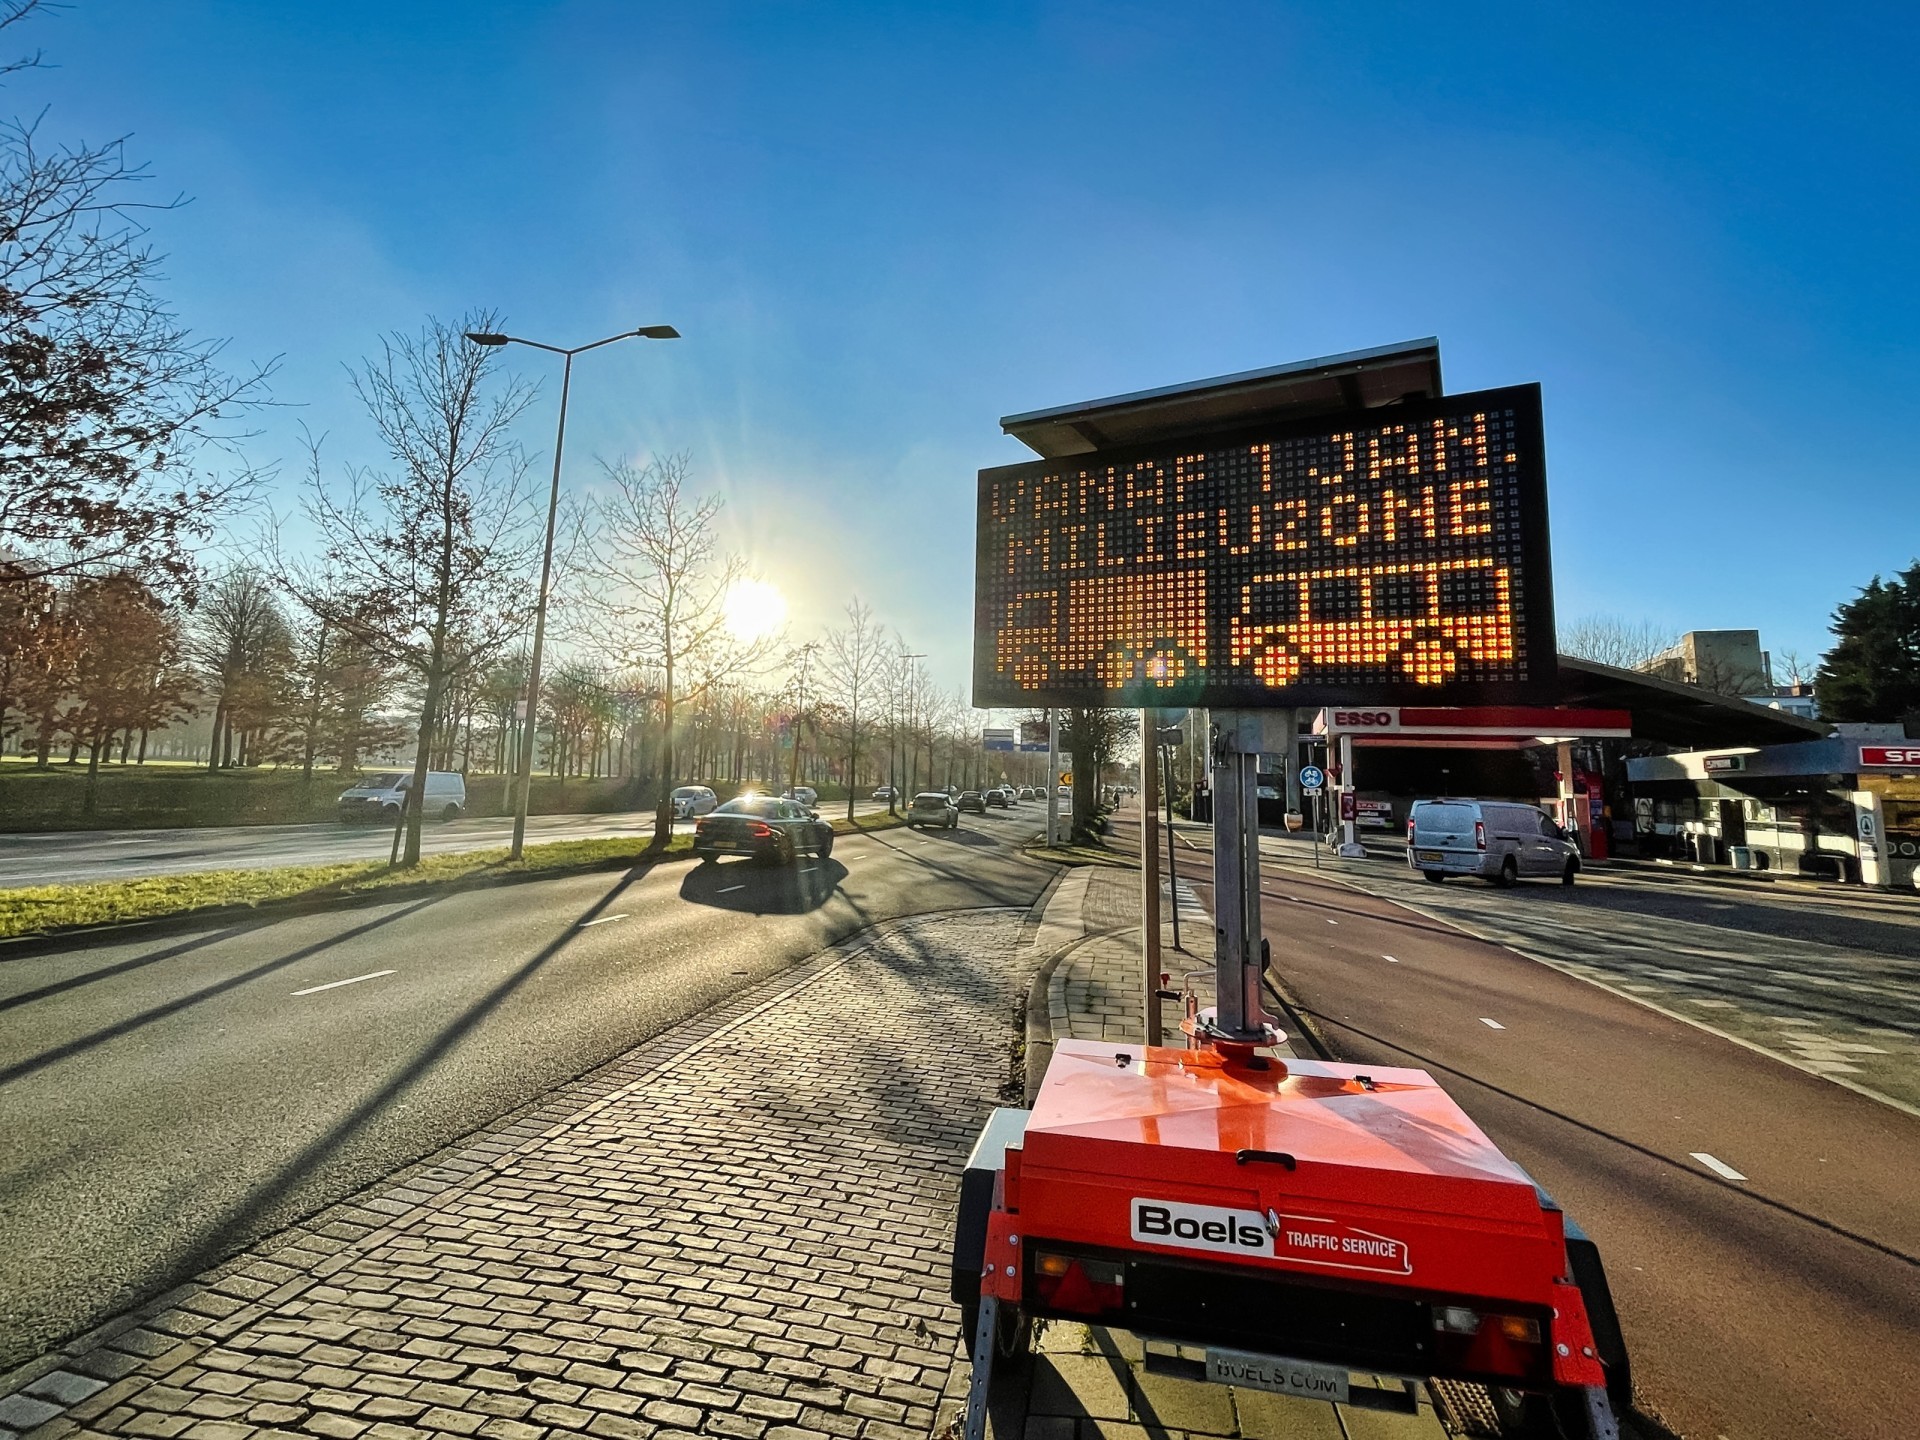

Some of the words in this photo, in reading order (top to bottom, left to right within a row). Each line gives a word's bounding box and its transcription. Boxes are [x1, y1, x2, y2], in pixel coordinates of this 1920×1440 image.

[992, 453, 1205, 523] VANAF
[1250, 443, 1271, 492] 1
[1308, 411, 1517, 485] JAN.
[1008, 478, 1492, 574] MILIEUZONE
[1335, 712, 1392, 726] ESSO
[1138, 1205, 1264, 1247] Boels
[1286, 1231, 1339, 1251] TRAFFIC
[1341, 1238, 1397, 1258] SERVICE
